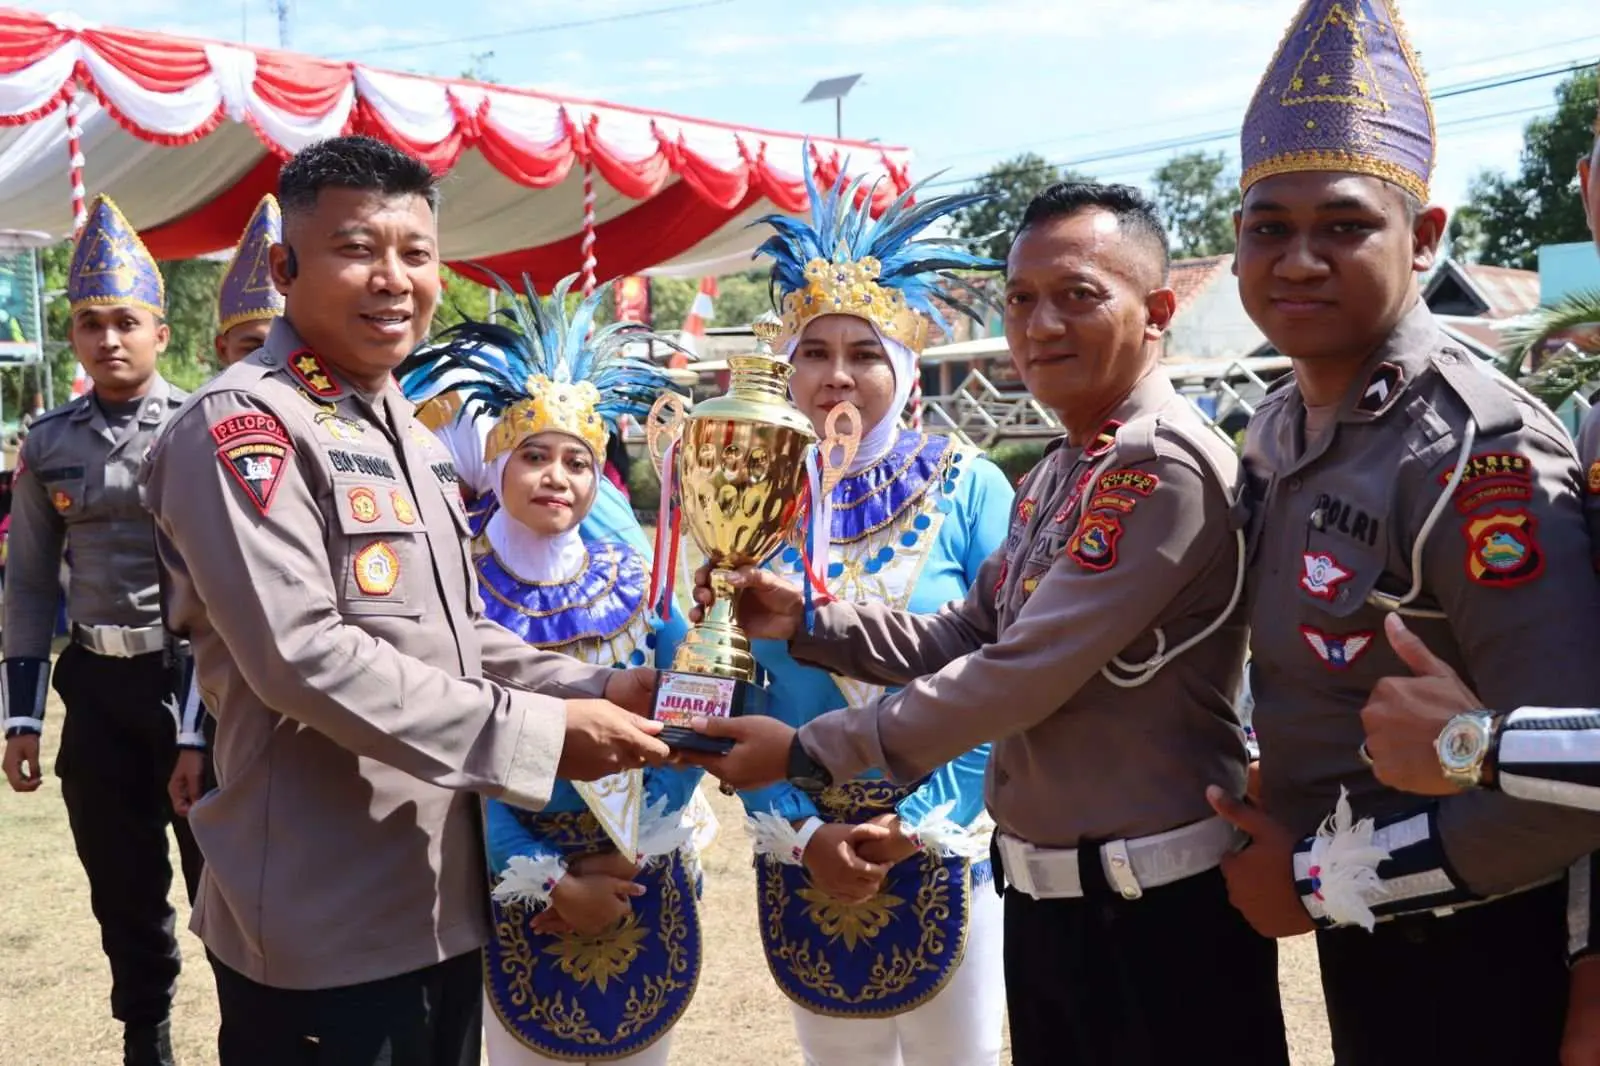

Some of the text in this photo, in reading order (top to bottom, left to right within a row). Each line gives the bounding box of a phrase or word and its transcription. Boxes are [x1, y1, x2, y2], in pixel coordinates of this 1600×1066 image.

[1101, 473, 1153, 488] POLRES
[1313, 493, 1378, 547] POLRI
[660, 695, 716, 717] JUARA
